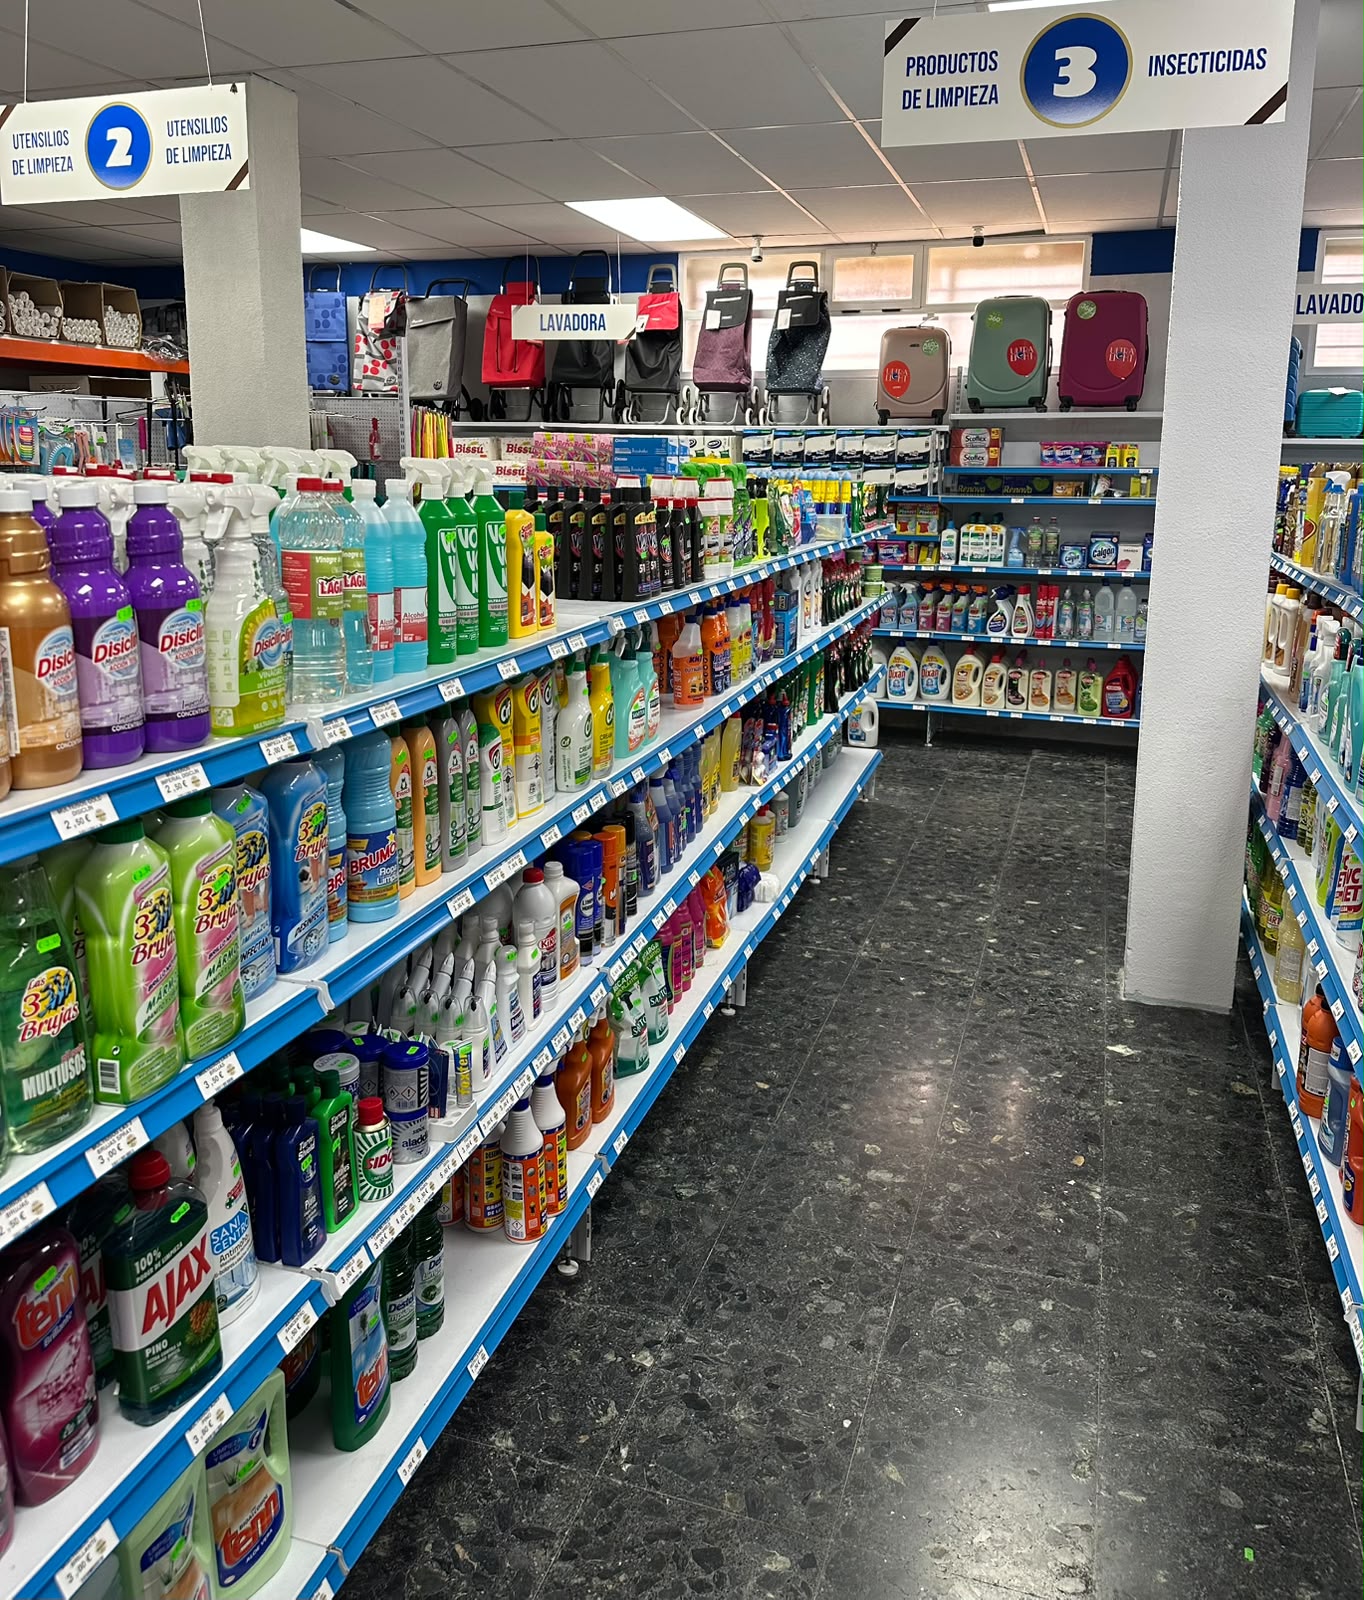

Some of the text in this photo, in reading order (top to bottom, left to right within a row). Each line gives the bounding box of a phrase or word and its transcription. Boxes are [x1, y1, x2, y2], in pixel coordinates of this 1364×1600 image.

[905, 50, 999, 77] PRODUCTOS
[1052, 45, 1097, 98] 3
[1148, 47, 1267, 77] INSECTICIDAS
[902, 84, 999, 110] DE LIMPIEZA
[167, 116, 228, 137] UTENSILIOS
[12, 129, 69, 150] UTENSILIOS
[105, 126, 133, 167] 2
[166, 143, 232, 165] DE LIMPIEZA
[12, 155, 73, 176] DE LIMPIEZA
[540, 313, 606, 331] LAVADORA
[455, 443, 484, 454] Bissú
[495, 465, 525, 476] Bissú
[1092, 547, 1115, 558] Calgon
[182, 780, 188, 788] €
[85, 813, 92, 822] €
[298, 822, 309, 841] 3
[236, 865, 271, 892] rujas
[197, 888, 213, 911] 3
[134, 914, 150, 940] 3
[22, 994, 40, 1017] 3
[18, 1002, 79, 1043] Brujas
[22, 1050, 87, 1101] MULTIUSOS
[203, 1071, 224, 1089] 3,50 €
[117, 1143, 123, 1153] €
[19, 1210, 27, 1220] €
[210, 1216, 241, 1245] SANI
[134, 1247, 162, 1275] 100%
[141, 1232, 211, 1336] AJAX
[145, 1339, 168, 1358] PINO
[208, 1420, 214, 1430] €
[212, 1437, 242, 1457] LIMPIEZA
[219, 1445, 241, 1460] BRILLO
[219, 1490, 280, 1566] tenn
[86, 1552, 93, 1563] €
[246, 1546, 260, 1564] ALOE
